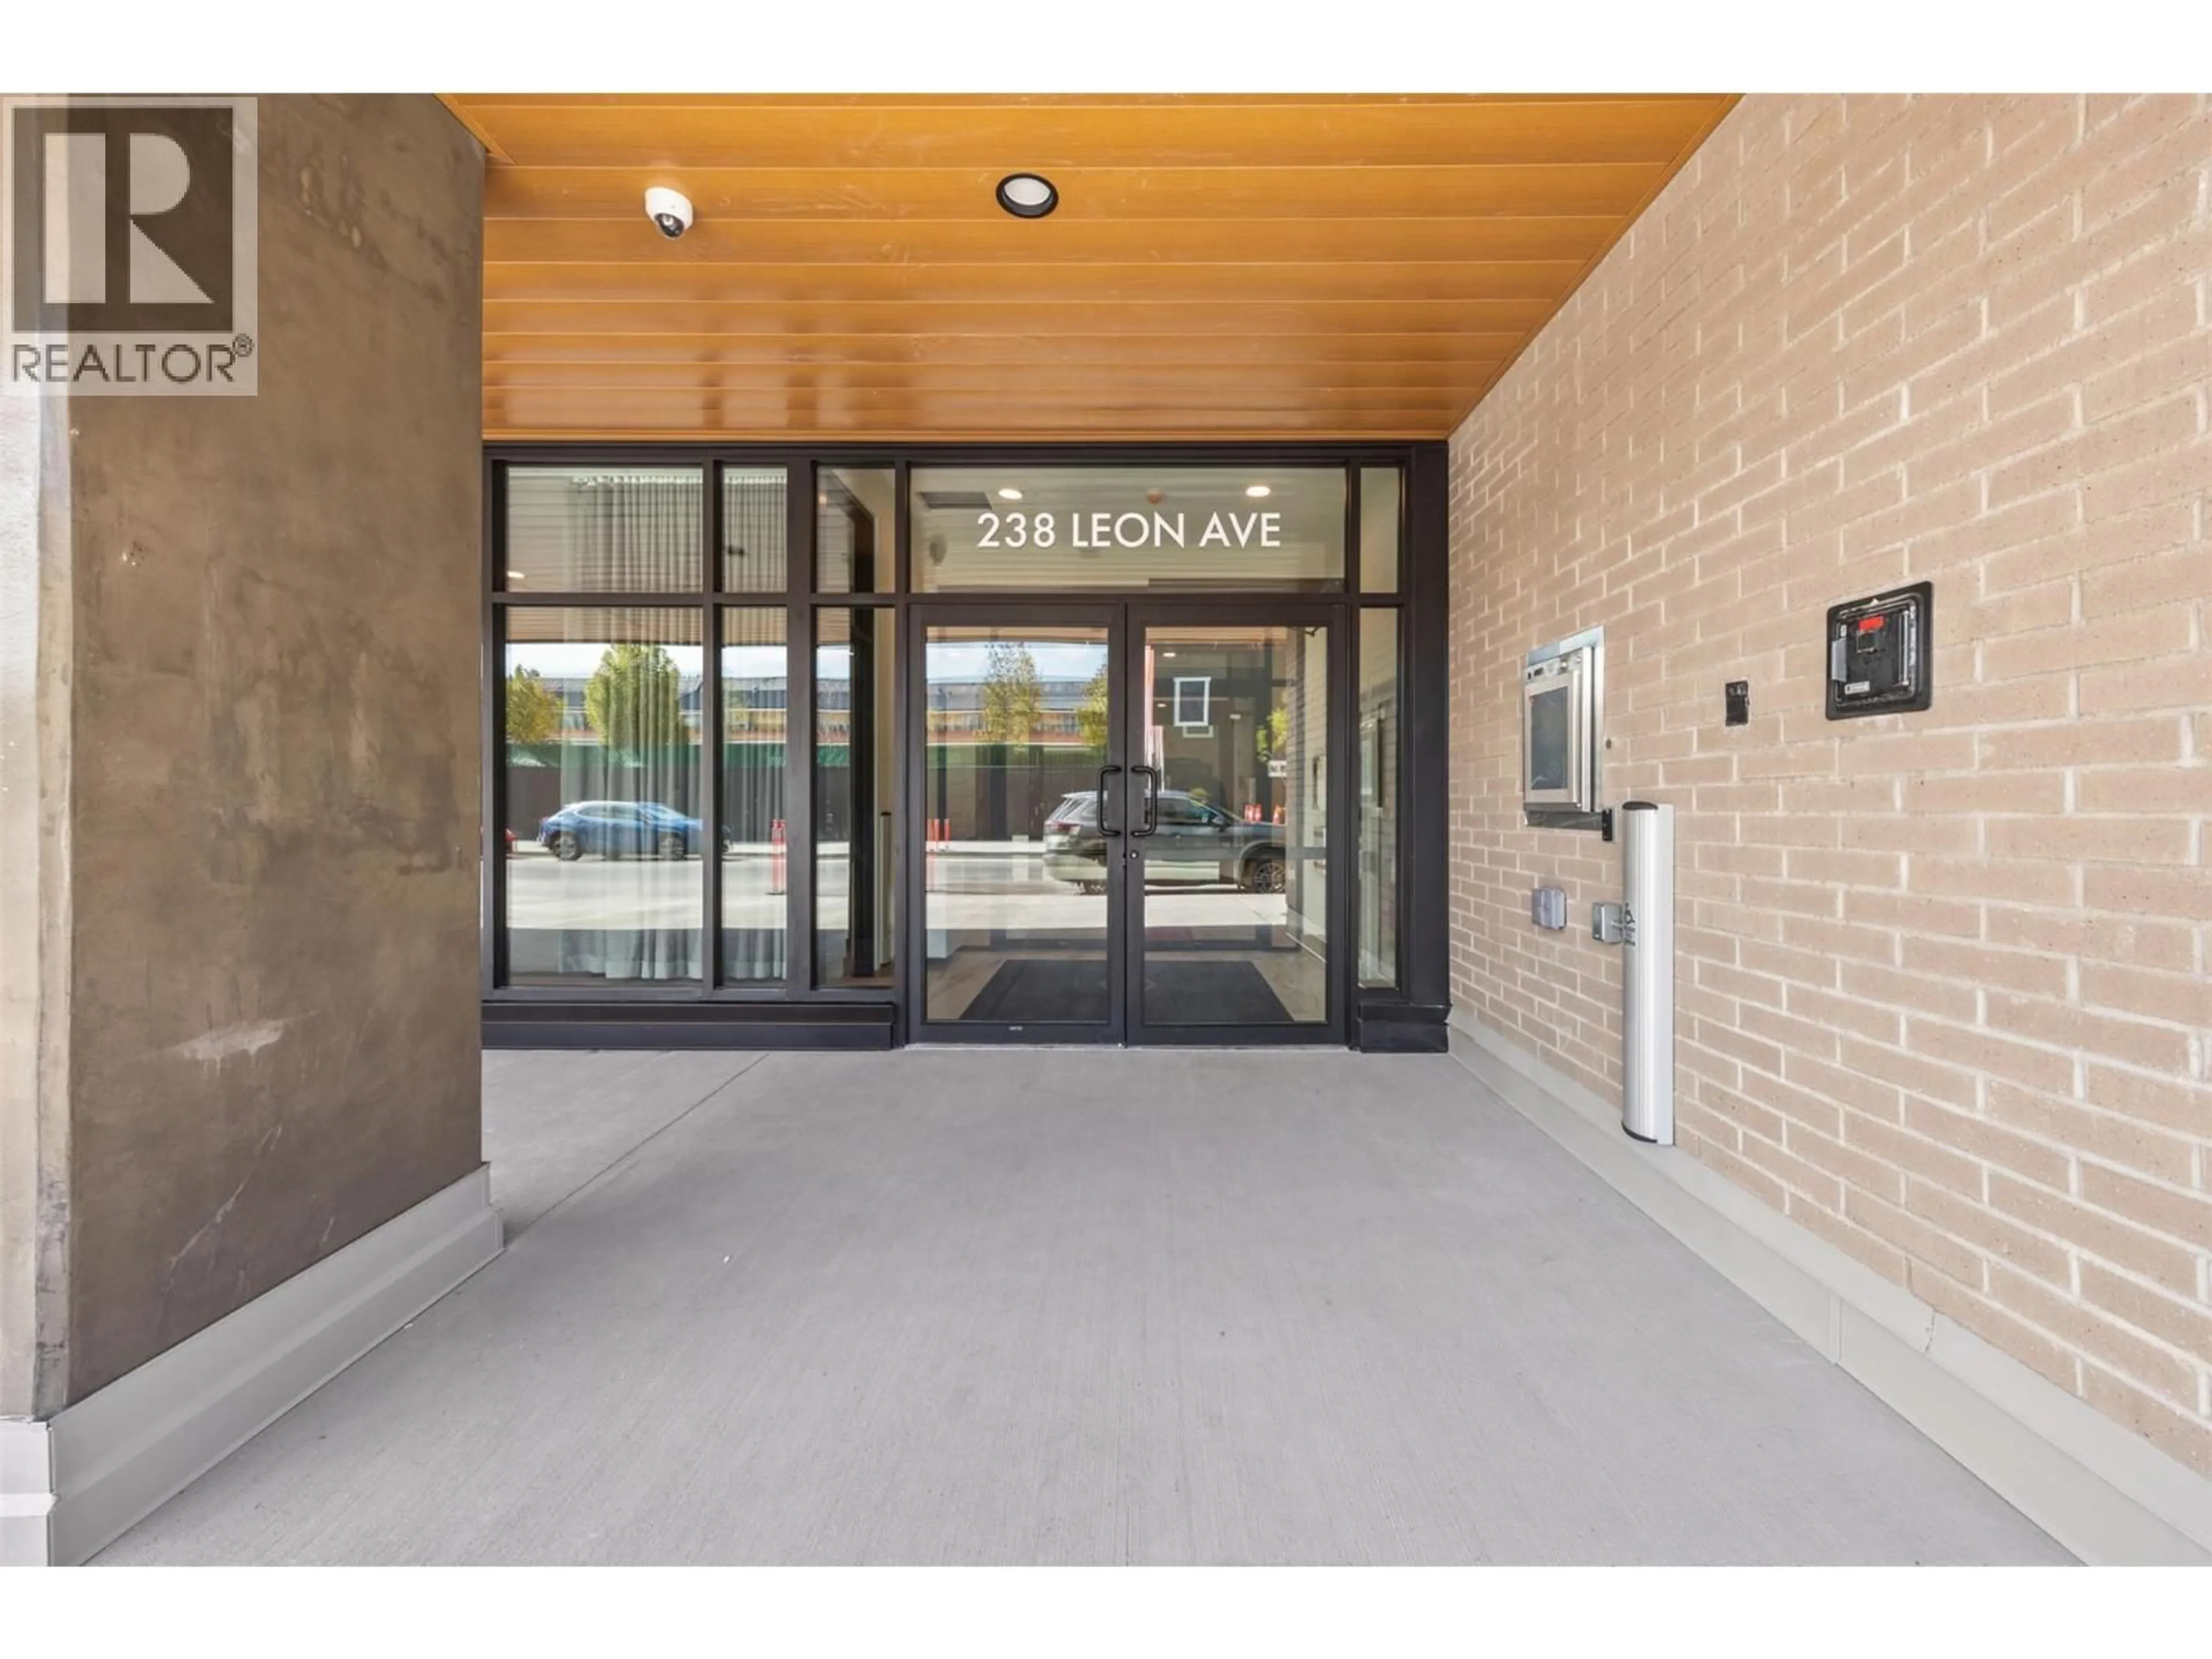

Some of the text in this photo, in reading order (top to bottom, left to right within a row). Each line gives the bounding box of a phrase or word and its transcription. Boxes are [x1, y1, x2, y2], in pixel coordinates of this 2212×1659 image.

[977, 512, 1281, 547] 238 LEON AVE
